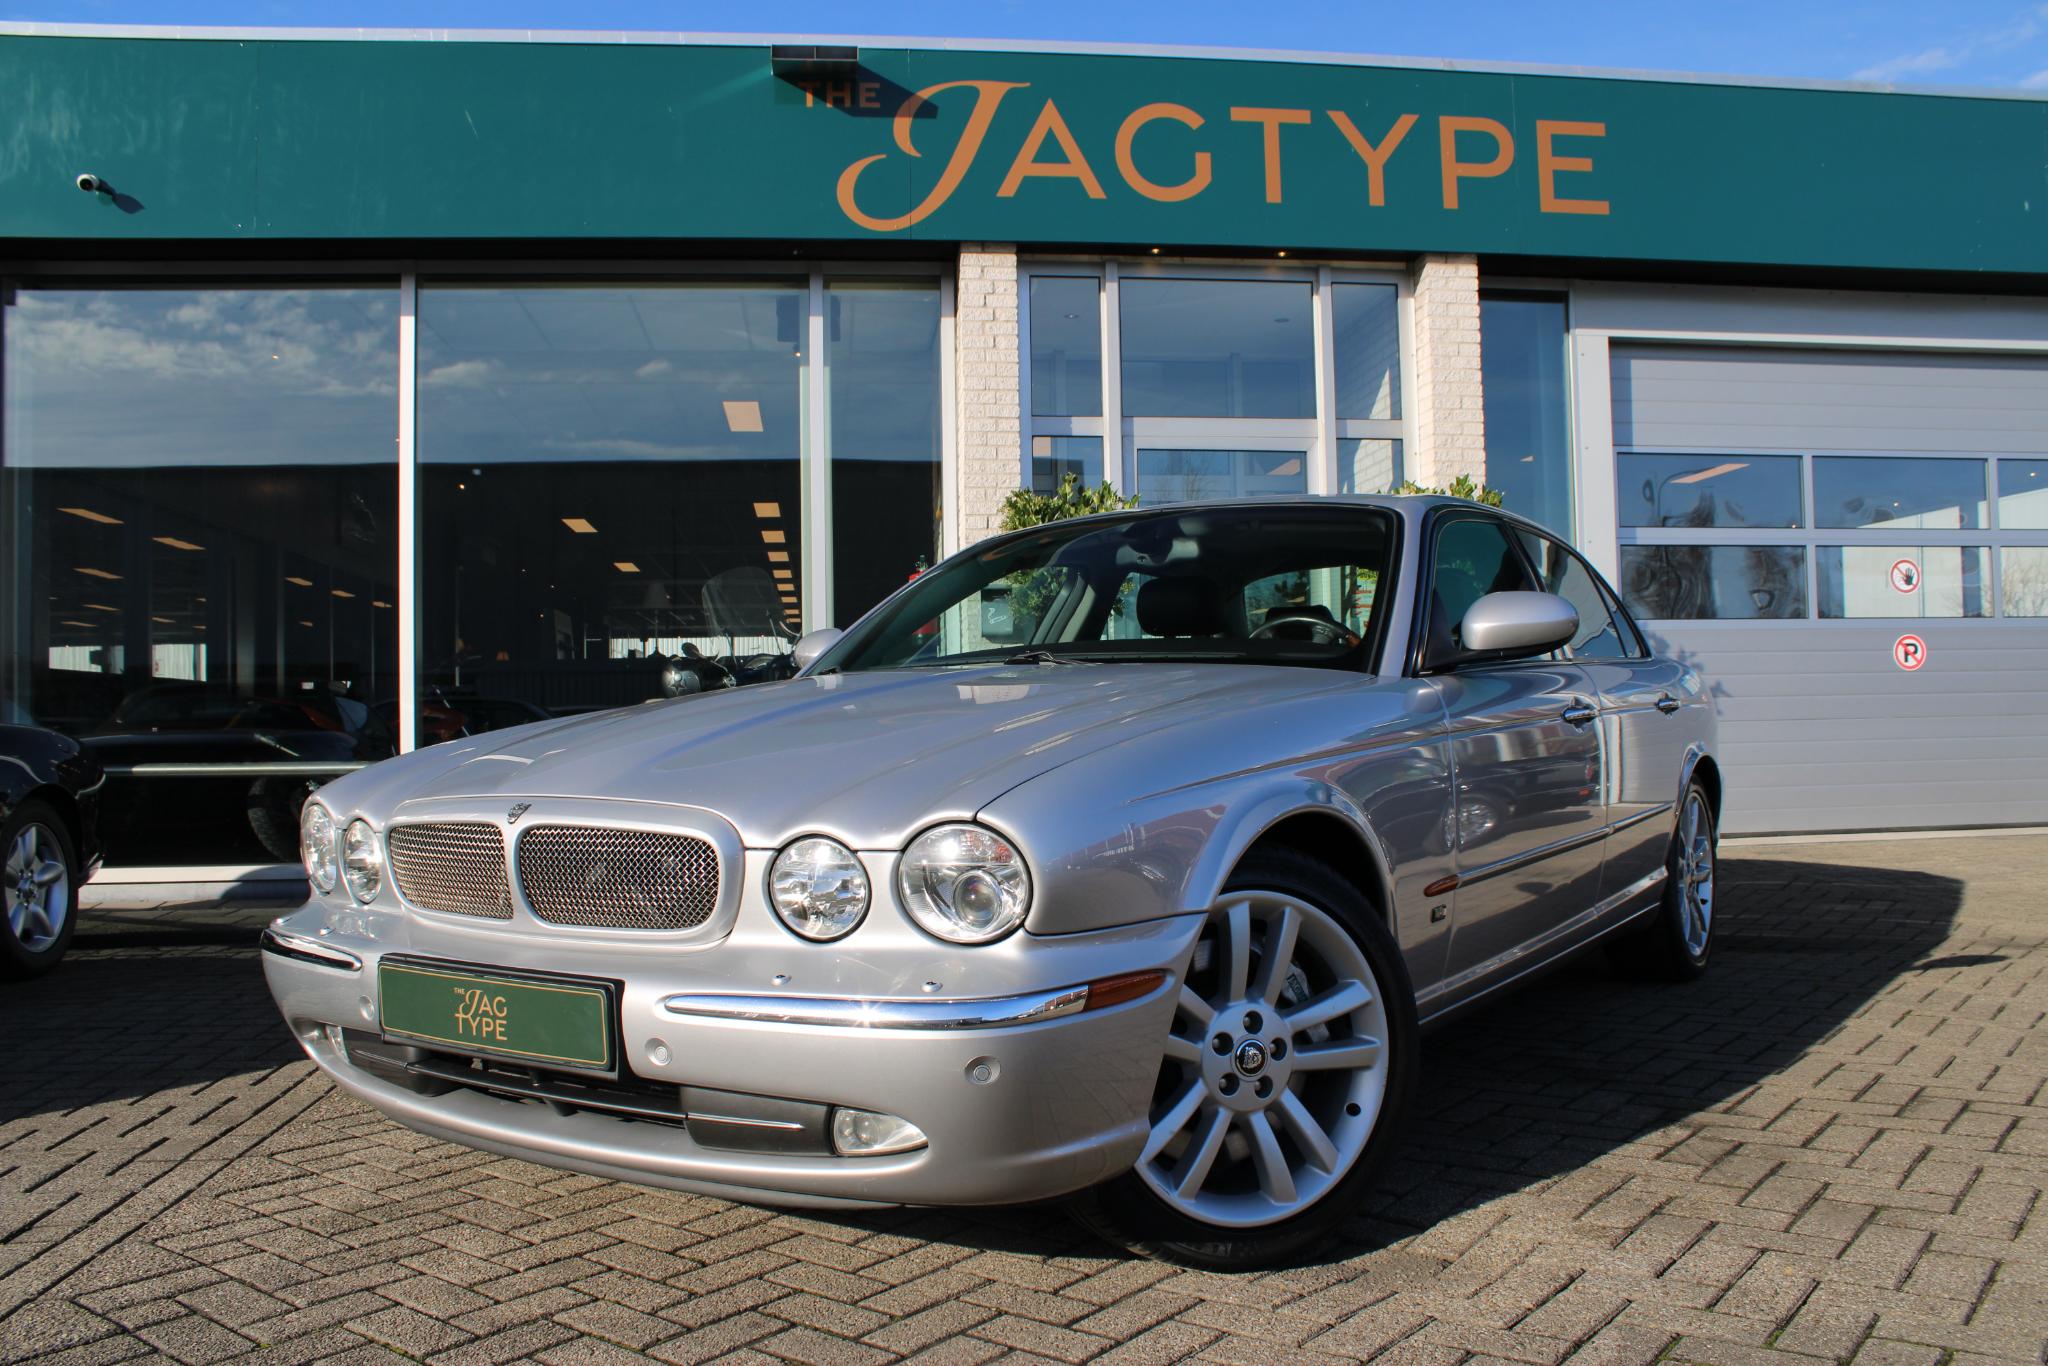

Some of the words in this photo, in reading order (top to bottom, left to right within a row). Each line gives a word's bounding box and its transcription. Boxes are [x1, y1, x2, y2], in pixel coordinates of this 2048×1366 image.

[799, 79, 880, 108] THE
[836, 80, 1610, 232] JAGTYPE
[459, 989, 507, 1017] JAG
[455, 1014, 508, 1040] TYPE
